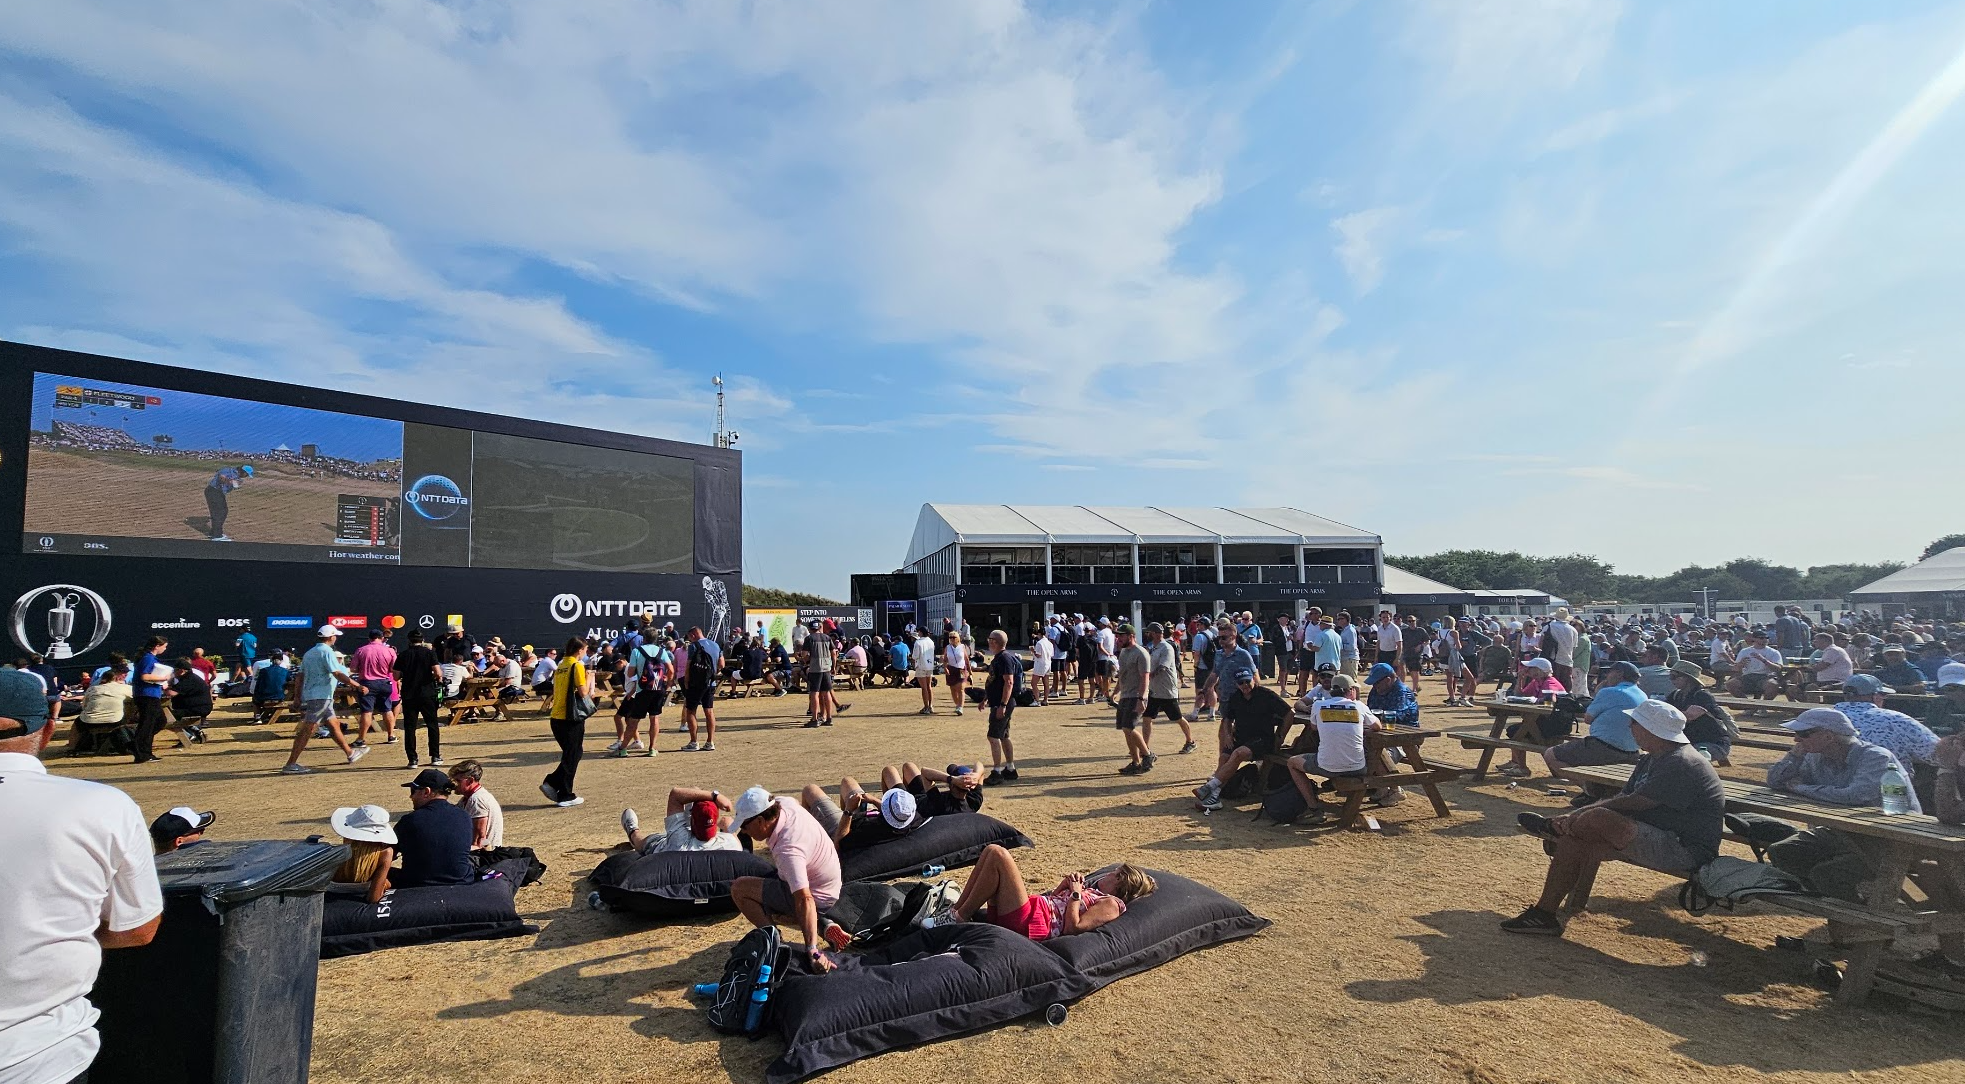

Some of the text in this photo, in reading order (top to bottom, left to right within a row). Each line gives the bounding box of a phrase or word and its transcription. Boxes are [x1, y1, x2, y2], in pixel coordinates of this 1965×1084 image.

[421, 494, 441, 503] NTT
[329, 550, 346, 558] Hot
[347, 551, 385, 560] weather
[585, 600, 628, 617] NTT
[151, 618, 201, 629] accenture
[217, 618, 251, 627] BOSS
[585, 627, 602, 640] AI
[605, 628, 618, 639] to
